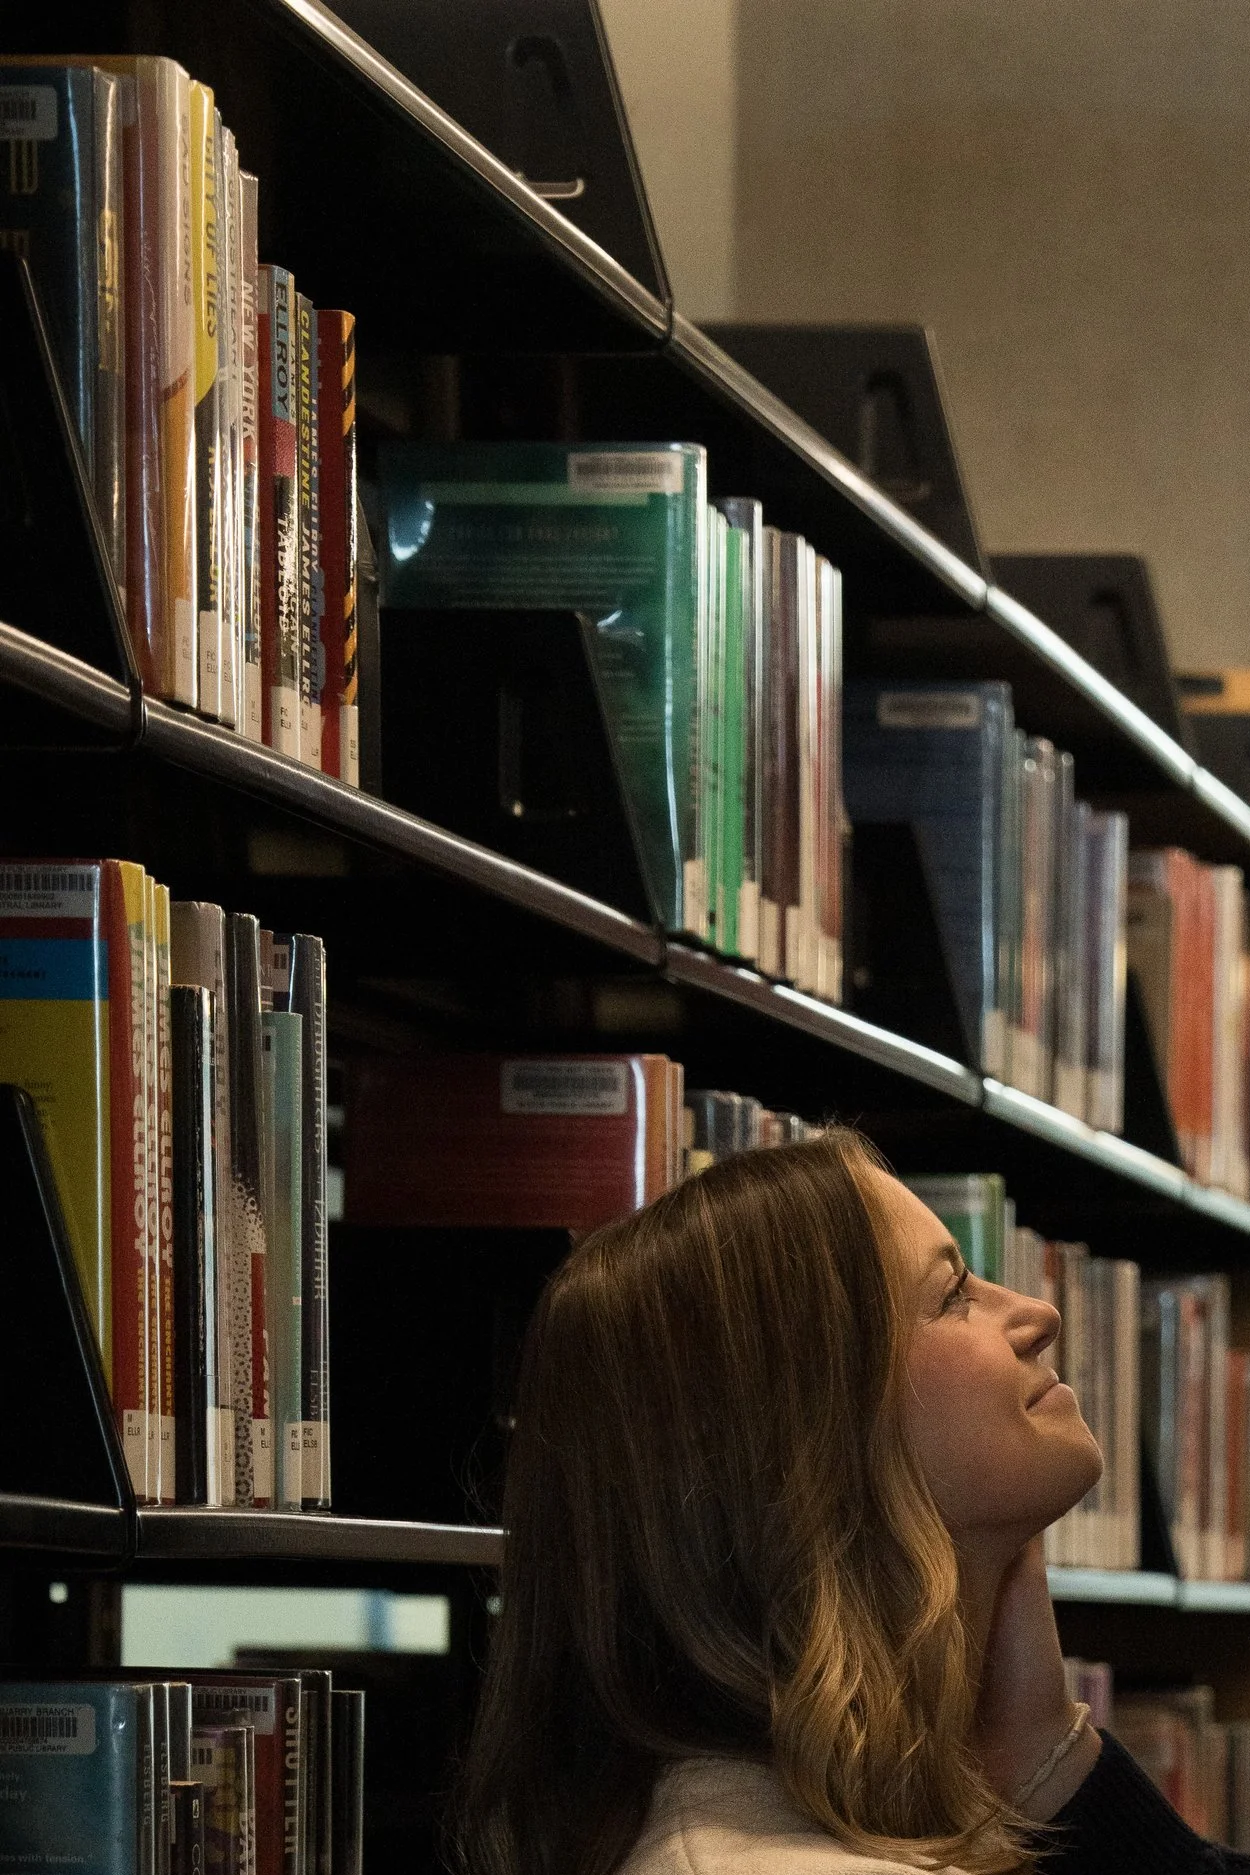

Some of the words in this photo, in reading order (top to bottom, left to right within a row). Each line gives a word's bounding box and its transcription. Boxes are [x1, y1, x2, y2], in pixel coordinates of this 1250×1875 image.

[206, 272, 218, 338] LIES
[242, 280, 255, 351] NEW
[276, 282, 289, 412] ELLROY
[242, 365, 256, 443] YORK
[301, 309, 310, 509] CLANDESTINE
[302, 522, 311, 616] JAMES
[131, 928, 146, 1079] JAMES
[159, 950, 171, 1092] JAMES
[133, 1094, 146, 1257] ELLROY
[161, 1109, 173, 1268] ELLROY
[310, 1369, 319, 1416] ELSB
[36, 1707, 75, 1717] BRANCH
[284, 1706, 299, 1854] SHUTTER
[18, 1853, 41, 1863] with
